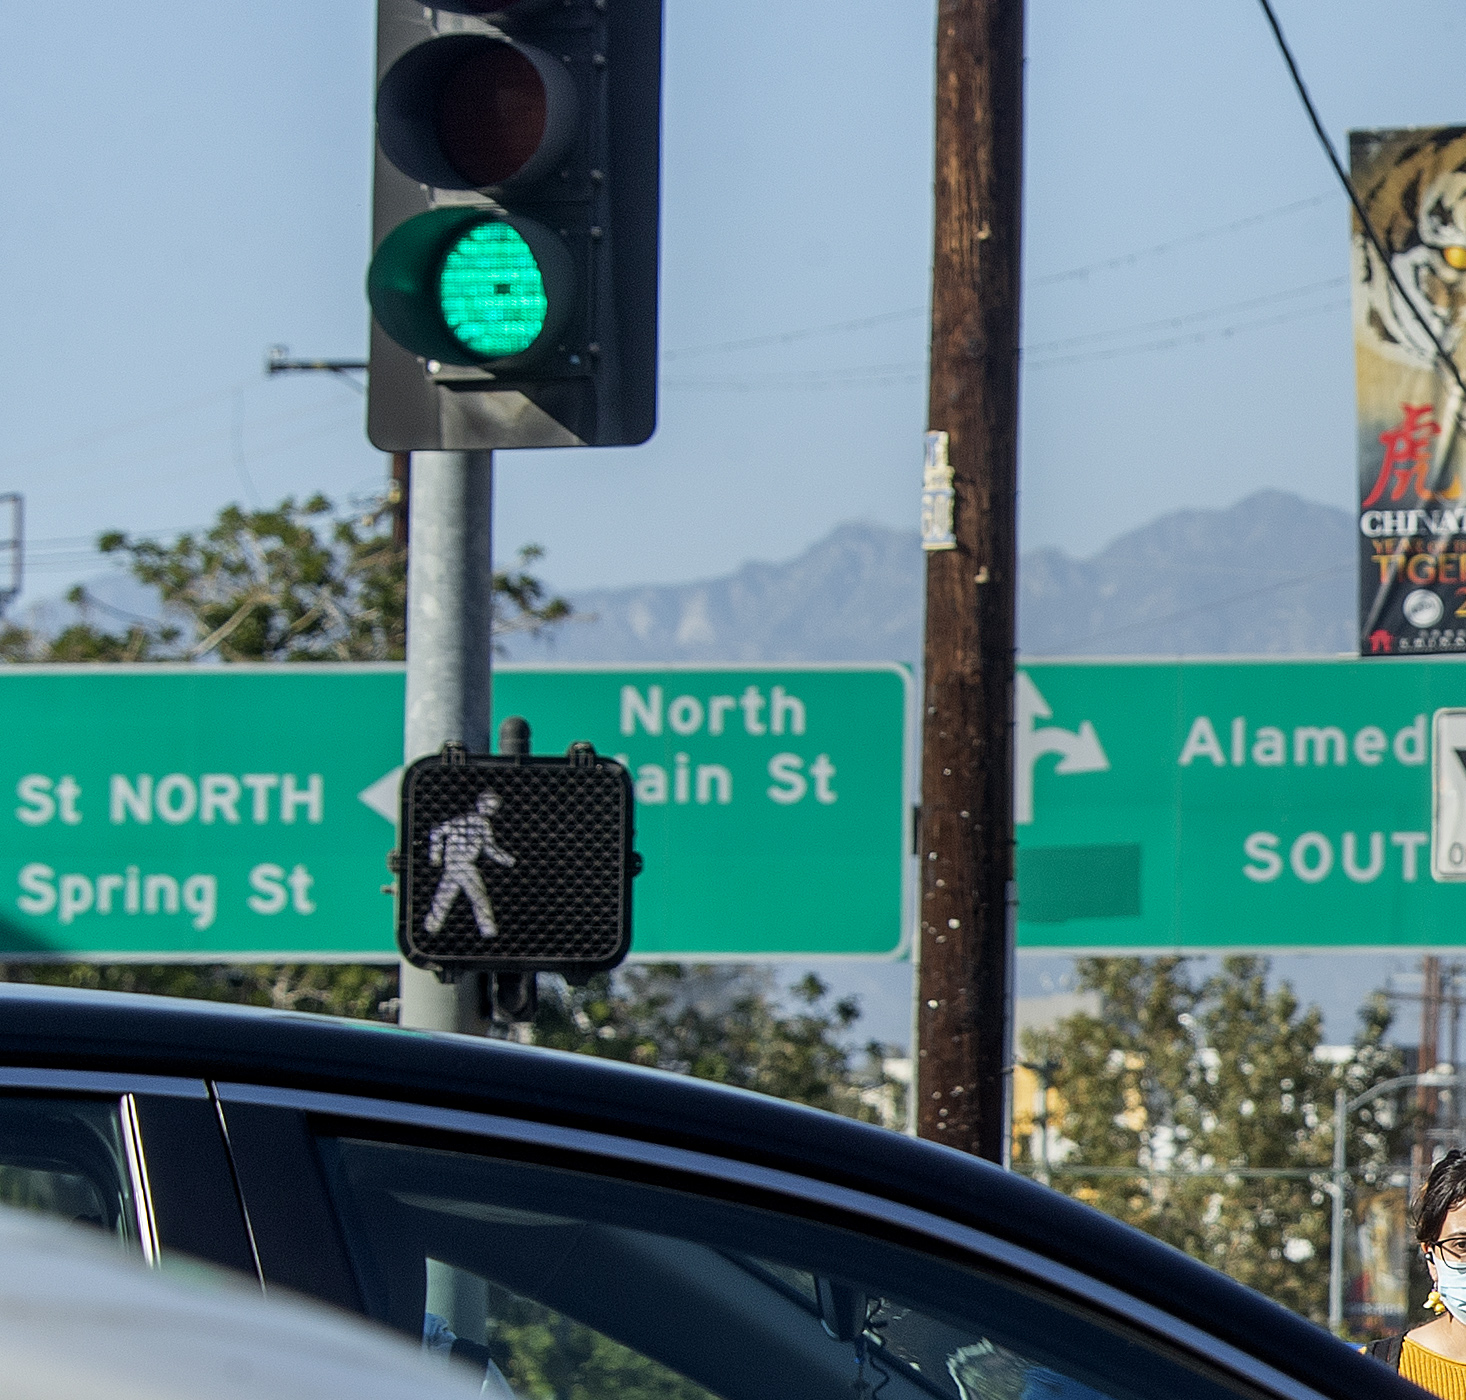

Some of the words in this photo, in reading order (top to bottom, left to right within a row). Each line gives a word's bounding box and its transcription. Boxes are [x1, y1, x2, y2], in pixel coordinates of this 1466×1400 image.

[1362, 402, 1462, 508] 虎
[619, 685, 806, 737] North
[1178, 715, 1428, 766] Alamed
[15, 773, 82, 827] St
[110, 773, 324, 826] NORTH
[633, 755, 732, 806] ain
[767, 752, 838, 807] St
[1243, 832, 1429, 882] SOUT
[16, 863, 216, 929] Spring
[248, 863, 316, 916] St
